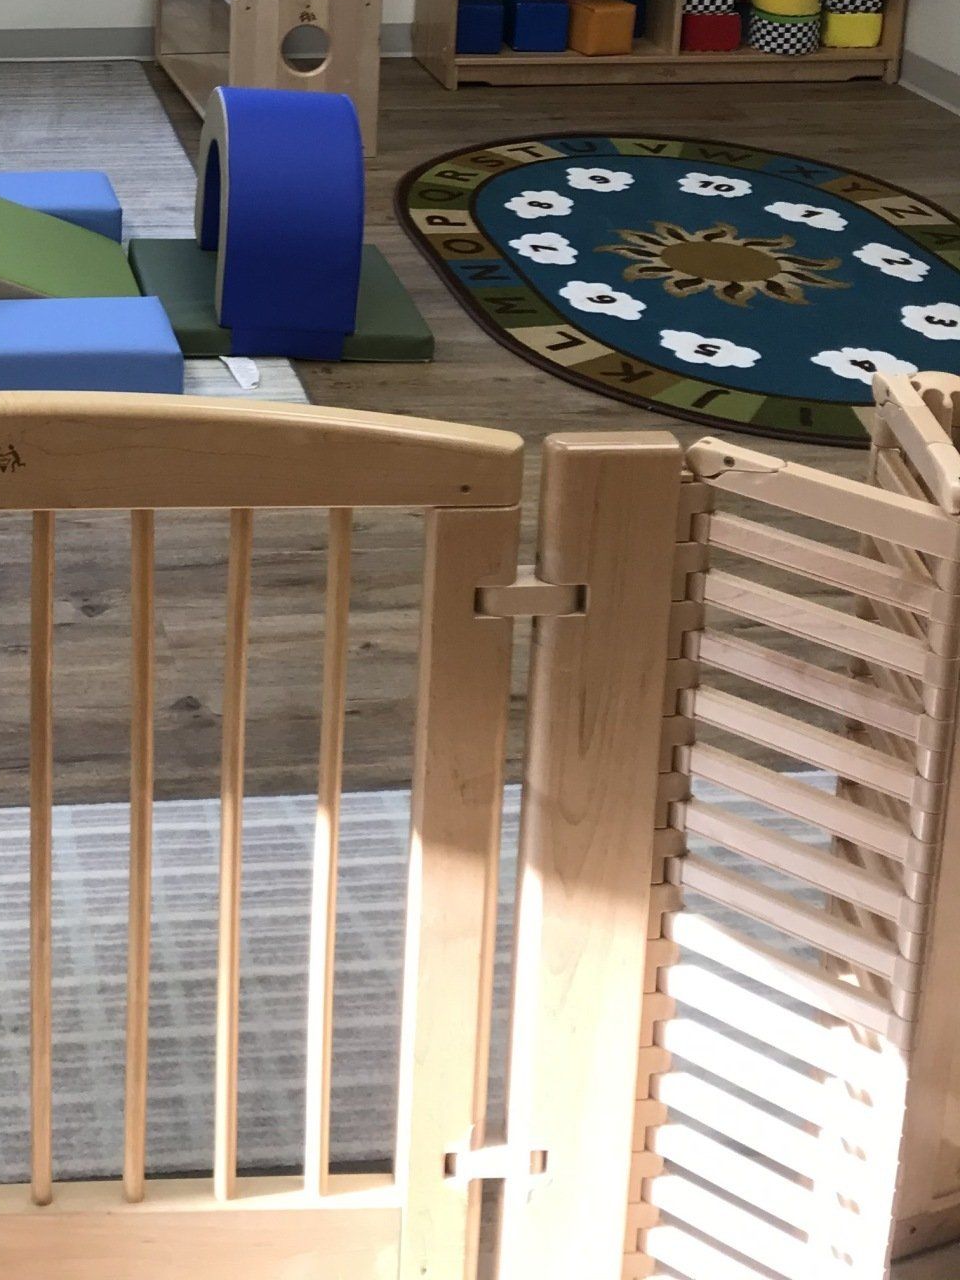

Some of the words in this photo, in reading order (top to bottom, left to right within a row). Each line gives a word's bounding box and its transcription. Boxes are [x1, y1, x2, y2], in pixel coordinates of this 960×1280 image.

[507, 145, 544, 158] T
[434, 169, 479, 183] R
[588, 174, 610, 185] 9
[698, 180, 735, 192] 10
[527, 200, 554, 210] 8
[800, 209, 823, 218] 1
[426, 215, 467, 227] P
[530, 243, 558, 253] 7
[882, 257, 913, 267] 2
[925, 315, 958, 328] 3
[546, 331, 586, 352] L
[694, 343, 721, 357] 5
[601, 362, 653, 383] K
